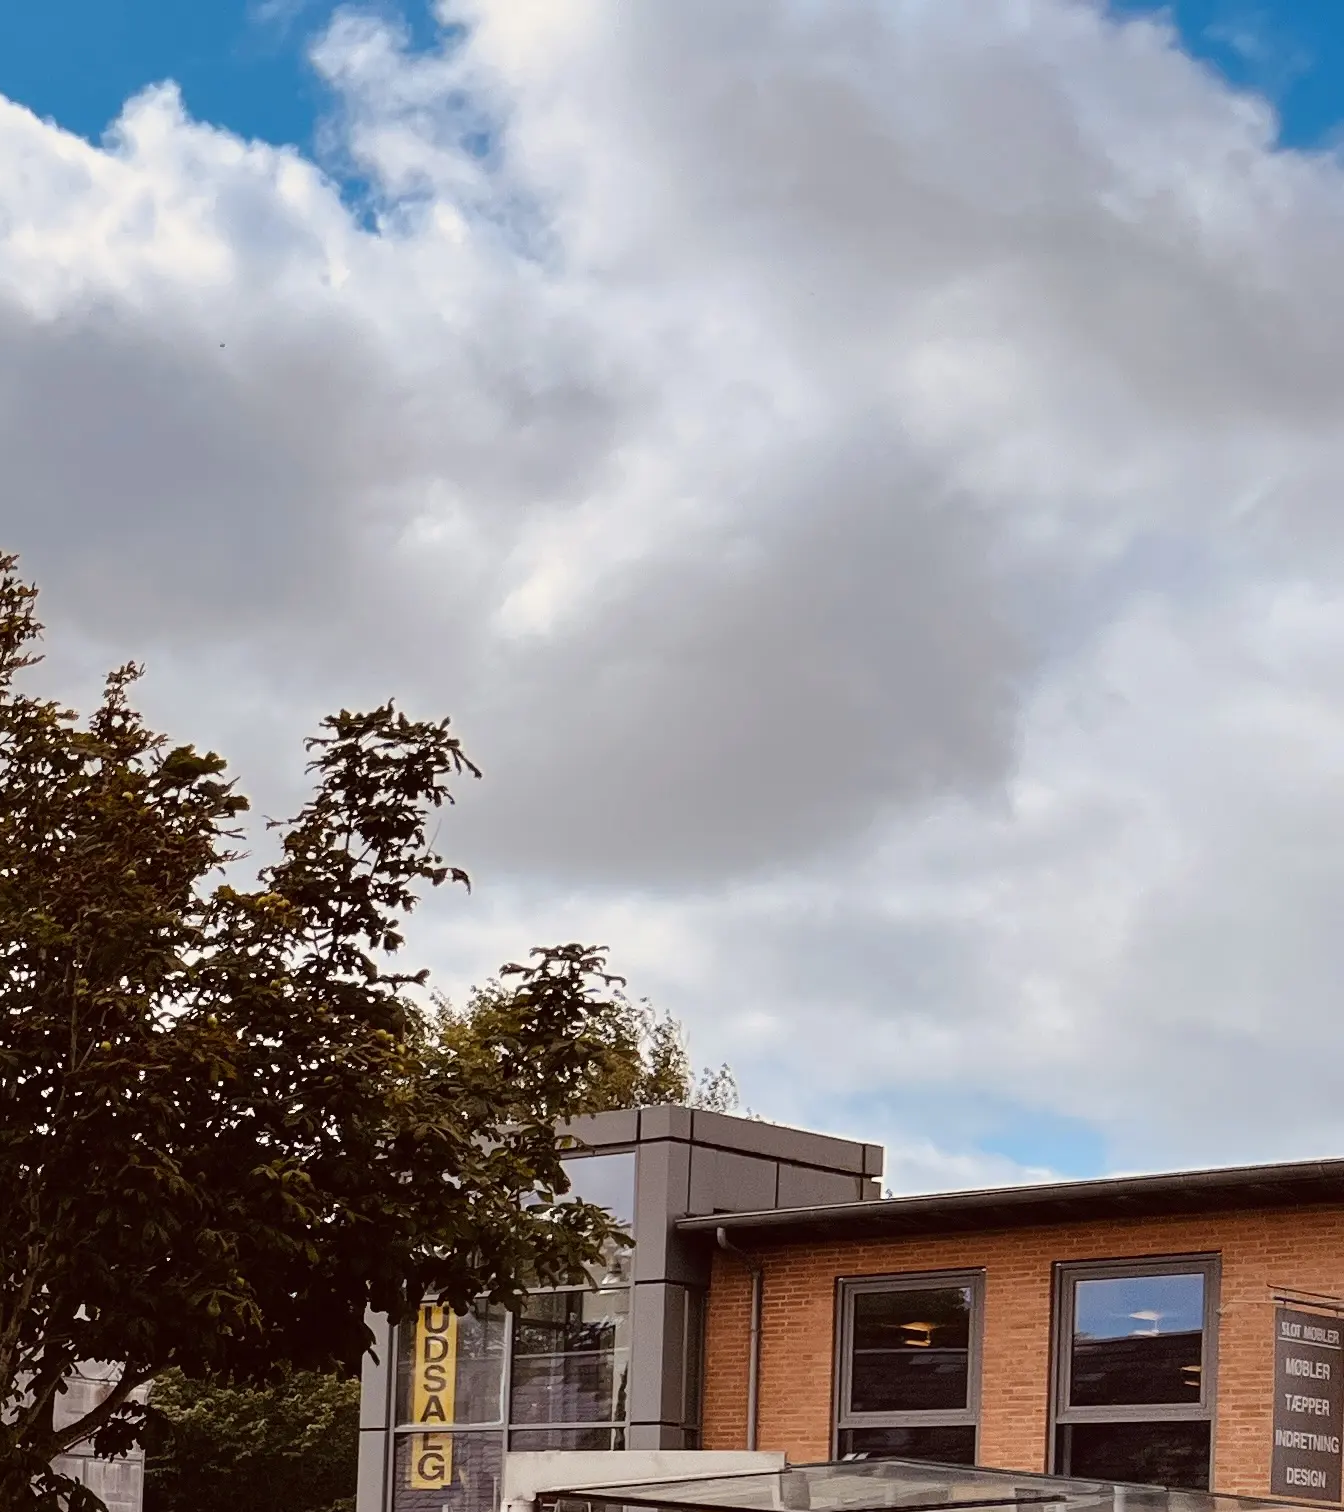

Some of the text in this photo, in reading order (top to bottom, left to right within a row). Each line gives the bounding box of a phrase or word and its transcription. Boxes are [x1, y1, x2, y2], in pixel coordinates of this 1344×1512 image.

[417, 1305, 450, 1481] UDSALG
[1284, 1393, 1331, 1417] TÆPPER
[1275, 1429, 1340, 1454] INDRETNING
[1286, 1467, 1327, 1489] DESIGN
